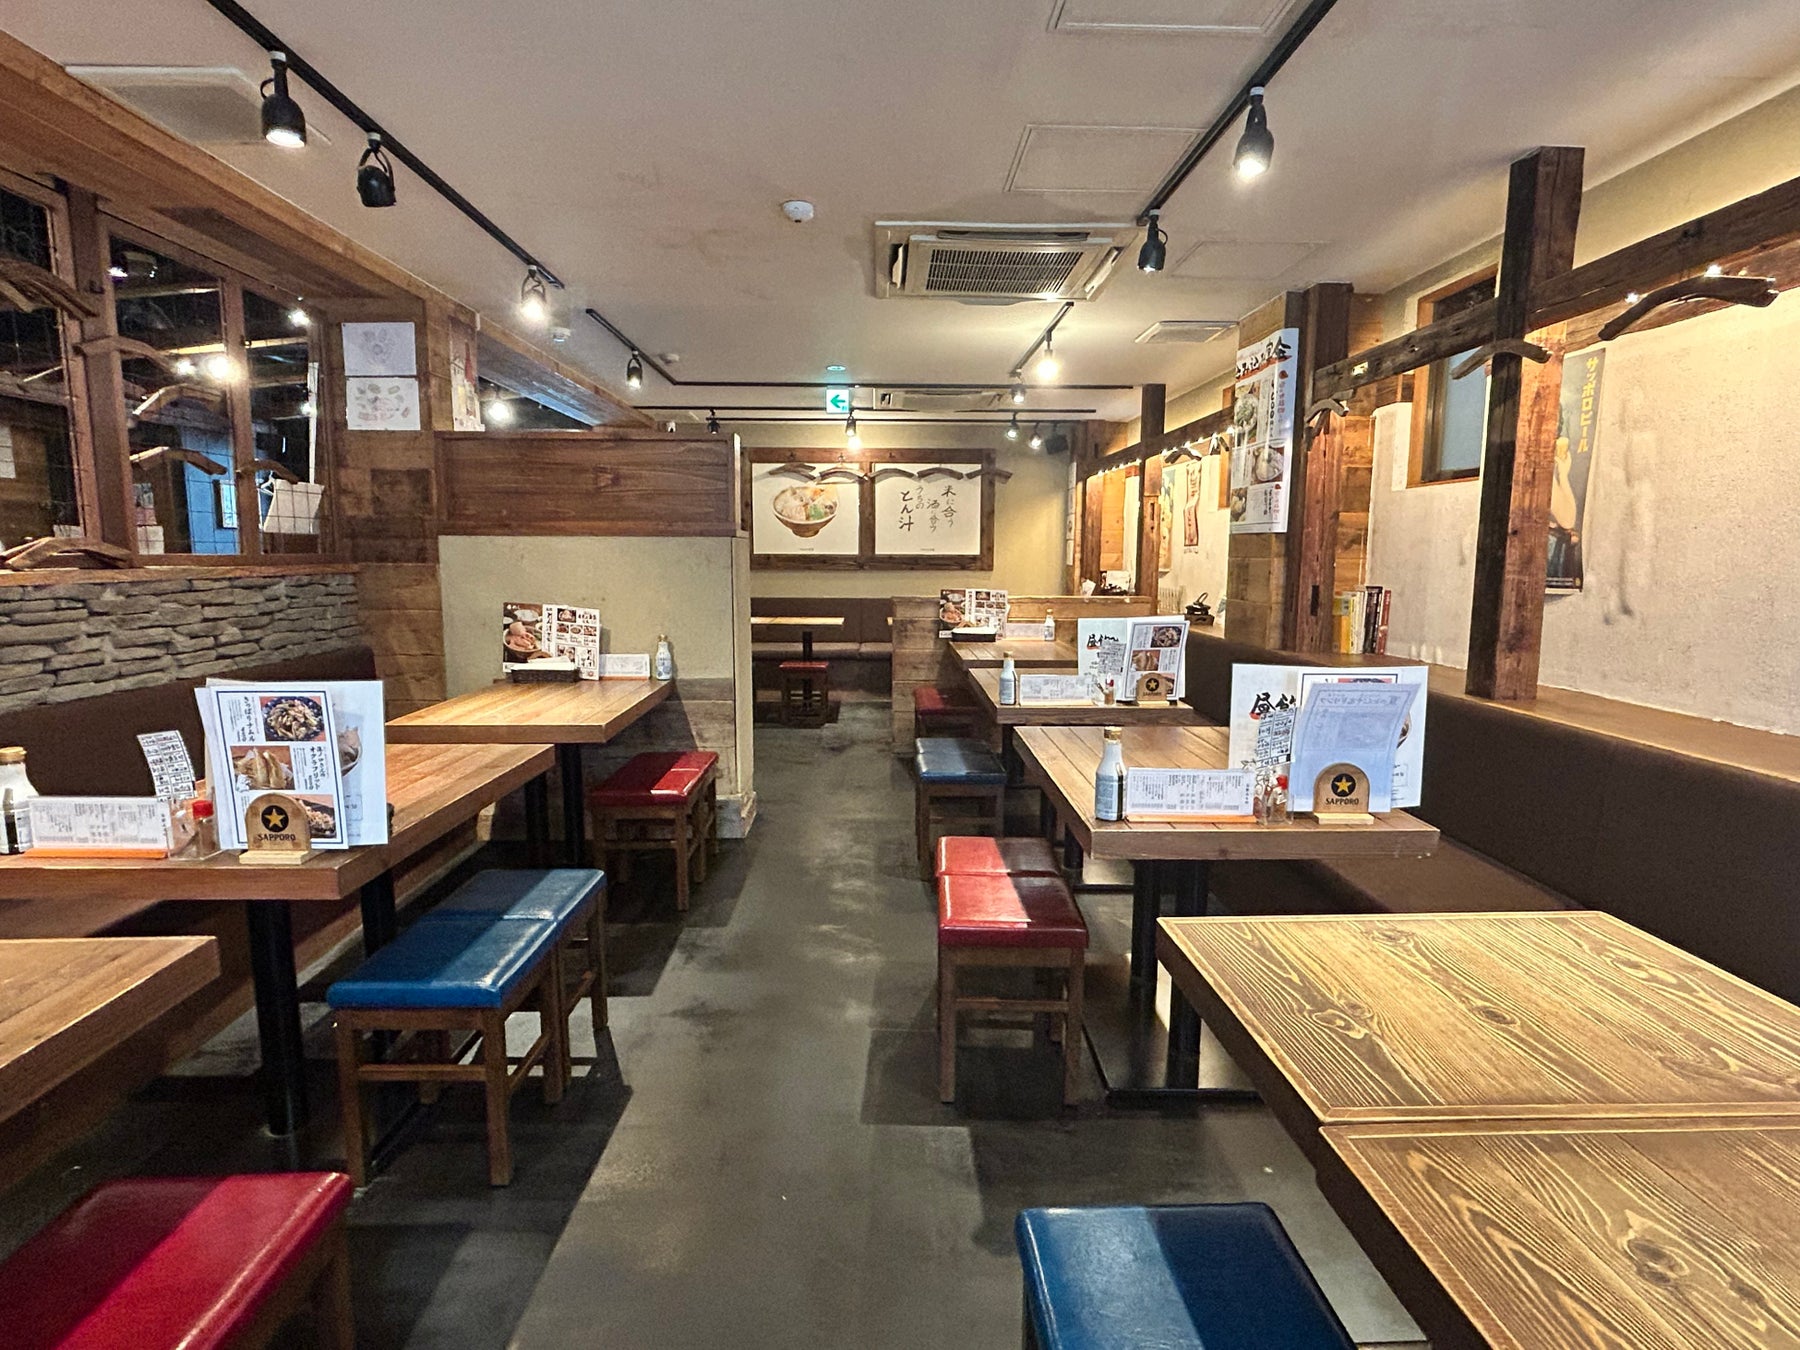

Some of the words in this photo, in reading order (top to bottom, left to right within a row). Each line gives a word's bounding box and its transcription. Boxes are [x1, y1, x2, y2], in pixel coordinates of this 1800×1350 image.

[1577, 356, 1599, 454] サッポロビール
[898, 490, 914, 532] とん汁
[915, 486, 925, 510] うちの
[941, 485, 957, 528] 米に合う
[1325, 797, 1360, 806] SAPPORO
[257, 833, 296, 842] SAPPORO
